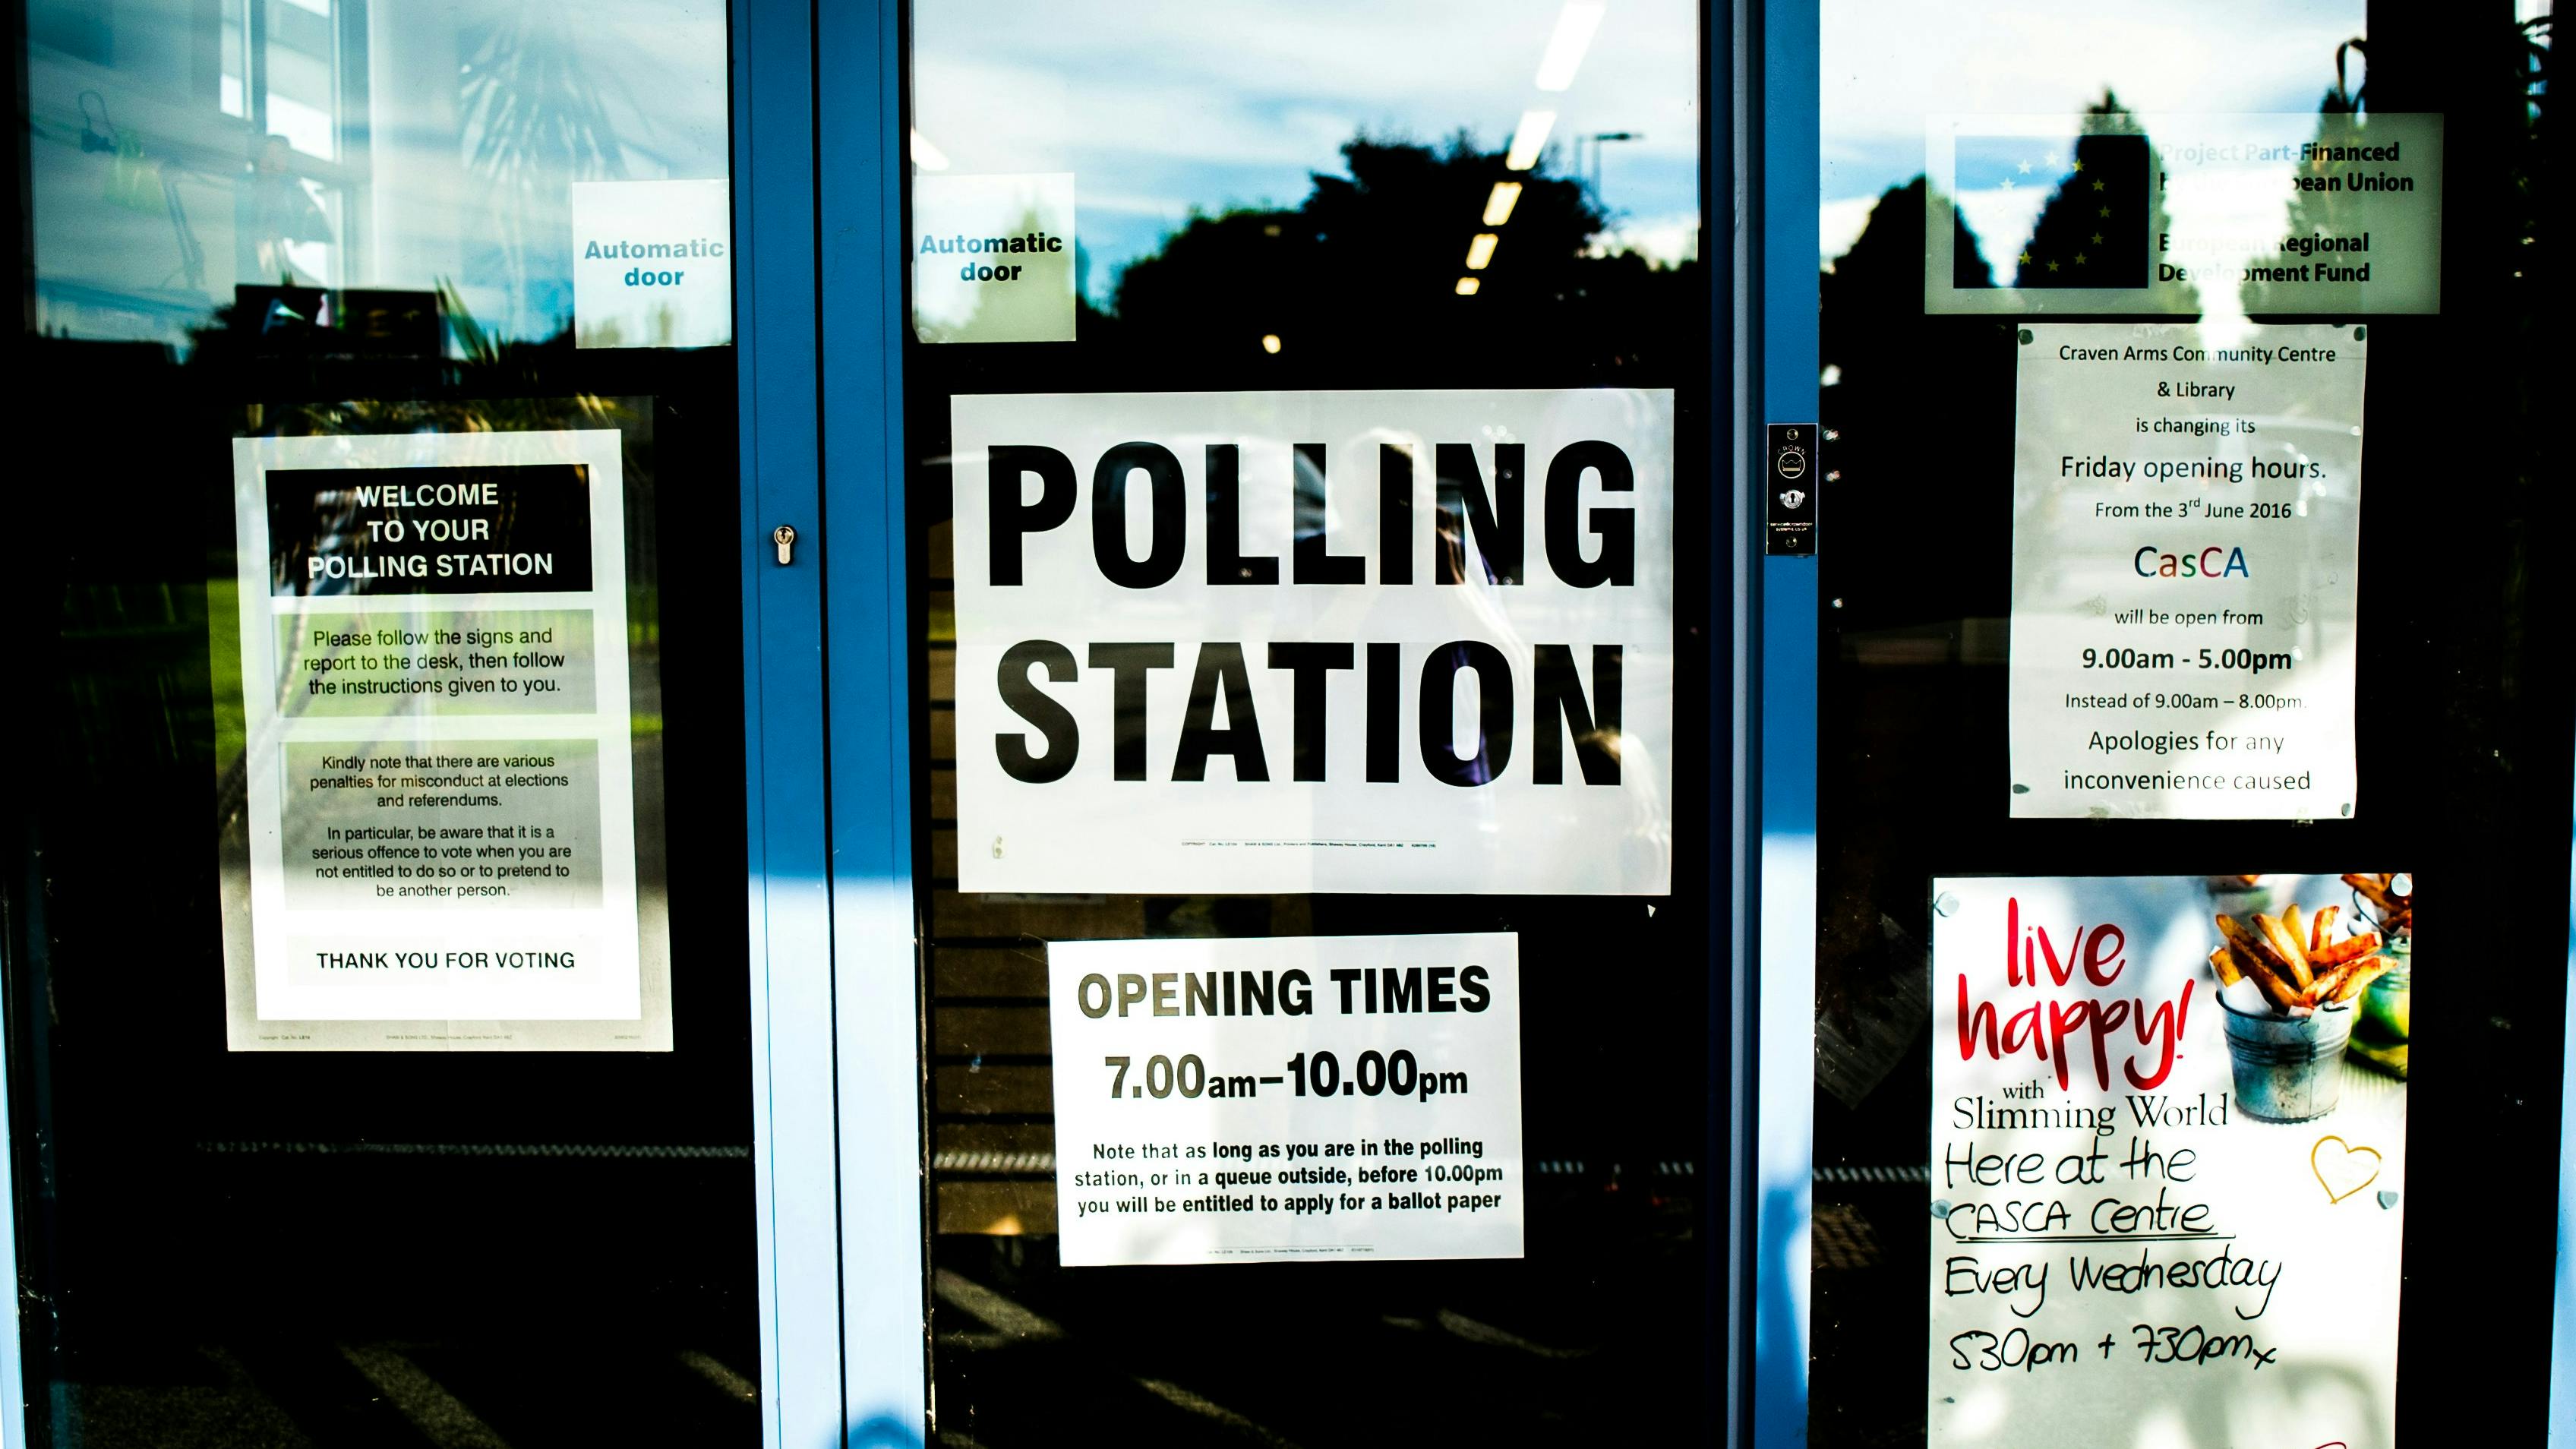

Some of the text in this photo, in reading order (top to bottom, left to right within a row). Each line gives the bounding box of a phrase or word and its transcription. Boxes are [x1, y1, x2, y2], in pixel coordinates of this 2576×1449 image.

[2246, 142, 2399, 162] Part-Financed
[2347, 172, 2414, 191] Union
[585, 238, 723, 259] Automatic
[920, 232, 1062, 254] Automatic
[625, 267, 683, 286] door
[961, 262, 1021, 281] door
[2315, 263, 2369, 282] Fund
[2060, 346, 2335, 365] Craven Arms Community Centre
[2177, 381, 2235, 401] Library
[2137, 418, 2256, 436] is changing its
[2062, 456, 2325, 483] Friday opening hours.
[356, 484, 498, 507] WELCOME
[988, 440, 1635, 589] POLLING
[2096, 503, 2139, 517] From
[2145, 502, 2172, 517] the
[2205, 504, 2243, 518] June
[2250, 504, 2291, 518] 2016
[368, 519, 488, 542] TO YOUR
[308, 554, 552, 579] POLLING STATION
[2135, 546, 2249, 577] CasCA
[2115, 609, 2262, 627] will be open from
[314, 627, 552, 647] Please follow the signs and
[305, 652, 565, 674] report to the desk, then follow
[2083, 649, 2291, 674] 9.00am 5.00pm
[309, 677, 560, 696] the instructions given to you.
[2066, 693, 2126, 708] Instead
[2133, 693, 2151, 708] of
[2155, 694, 2218, 708] 9.00am
[996, 639, 1623, 787] STATION
[2089, 731, 2284, 755] Apologies for any
[323, 754, 554, 772] Kindly note that there are various
[311, 774, 568, 791] penalties for misconduct at elections
[2065, 770, 2309, 789] inconvenience caused
[377, 794, 501, 807] and referendums.
[328, 826, 514, 843] In particular, be aware that
[312, 844, 571, 860] serious offence to vote when you are
[316, 864, 570, 879] not entitled to do so or to pretend to
[377, 884, 510, 898] be another person.
[2007, 897, 2126, 987] live
[317, 952, 574, 968] THANK YOU FOR VOTING
[1078, 965, 1490, 1018] OPENING TIMES
[1958, 973, 2195, 1092] happy!
[2003, 1079, 2044, 1100] with
[1953, 1093, 2227, 1136] Slimming World
[1094, 1138, 1482, 1162] Note that as long as you are in the polling
[1945, 1135, 2196, 1189] Here at the
[1075, 1165, 1502, 1189] station, or in queue outside, before 10.00pm
[1078, 1192, 1501, 1217] you will be entitled to apply for ballot paper
[1945, 1187, 2214, 1239] CASCA Centre
[1945, 1244, 2282, 1320] Every Wednesday
